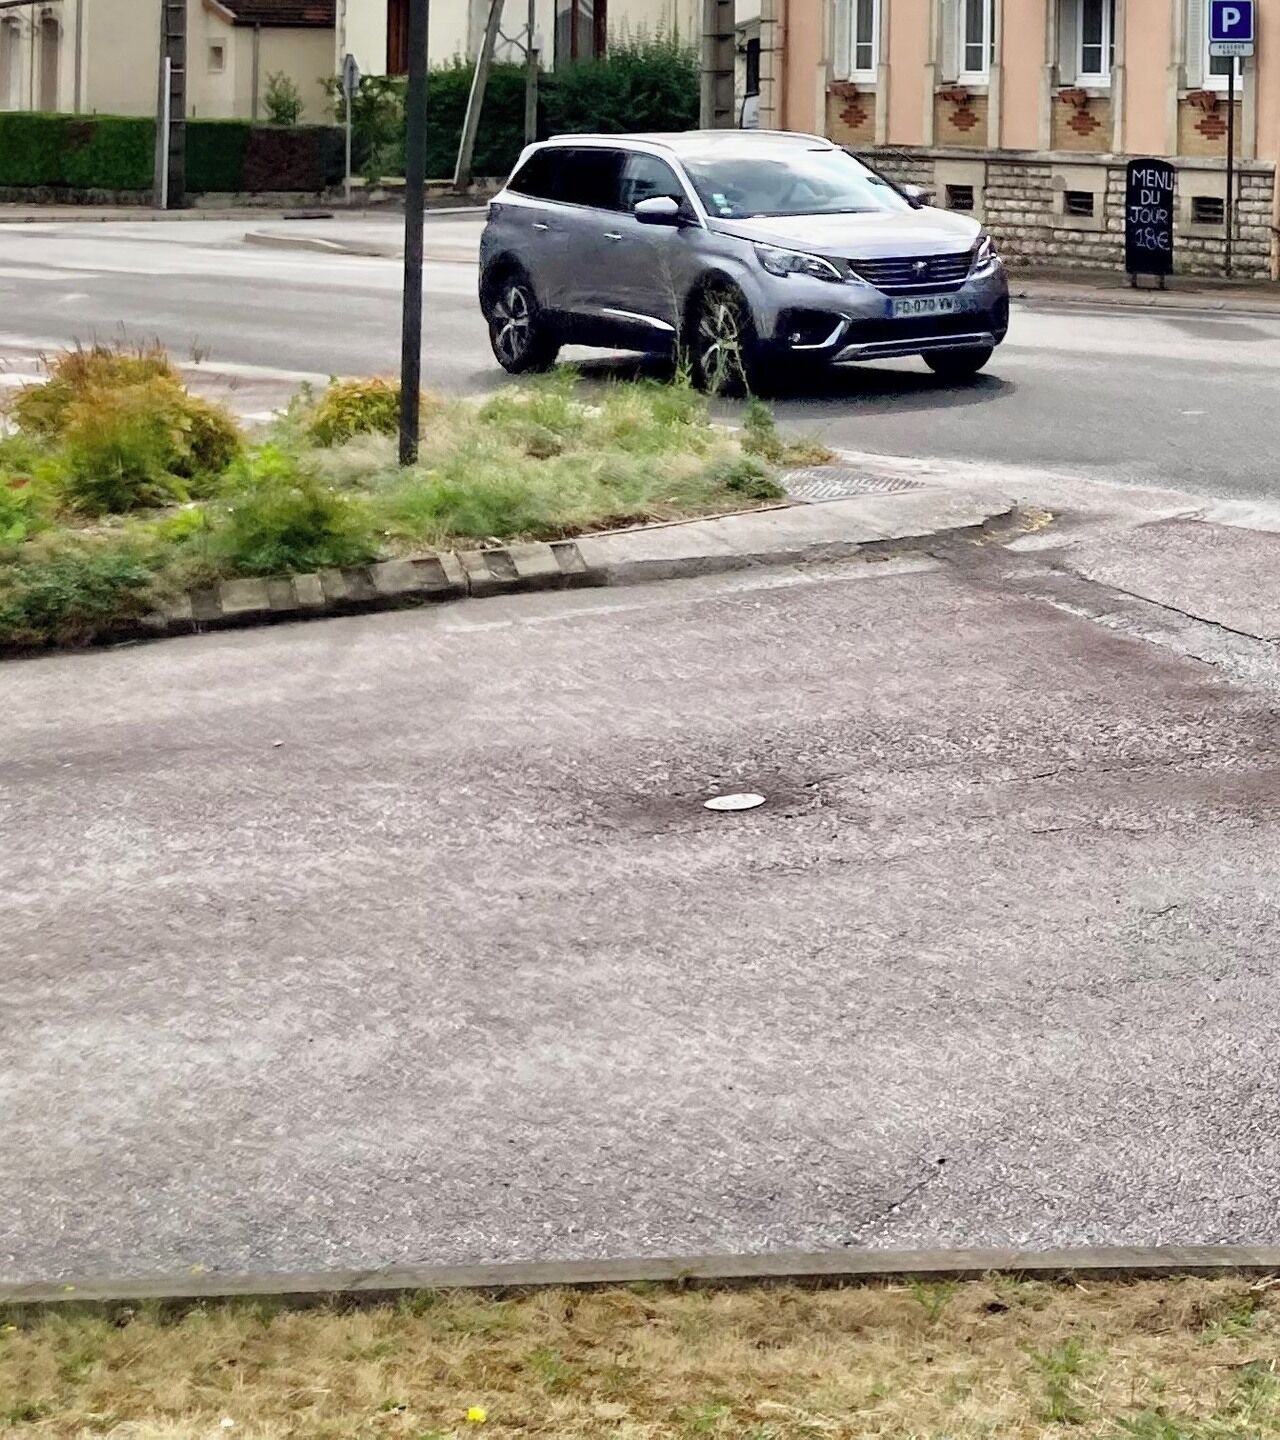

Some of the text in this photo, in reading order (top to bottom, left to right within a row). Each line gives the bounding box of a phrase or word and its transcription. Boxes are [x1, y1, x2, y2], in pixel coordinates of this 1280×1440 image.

[1132, 169, 1173, 190] MENU
[1140, 190, 1161, 205] DU
[1128, 206, 1168, 224] JOUR
[1135, 227, 1170, 250] 18€
